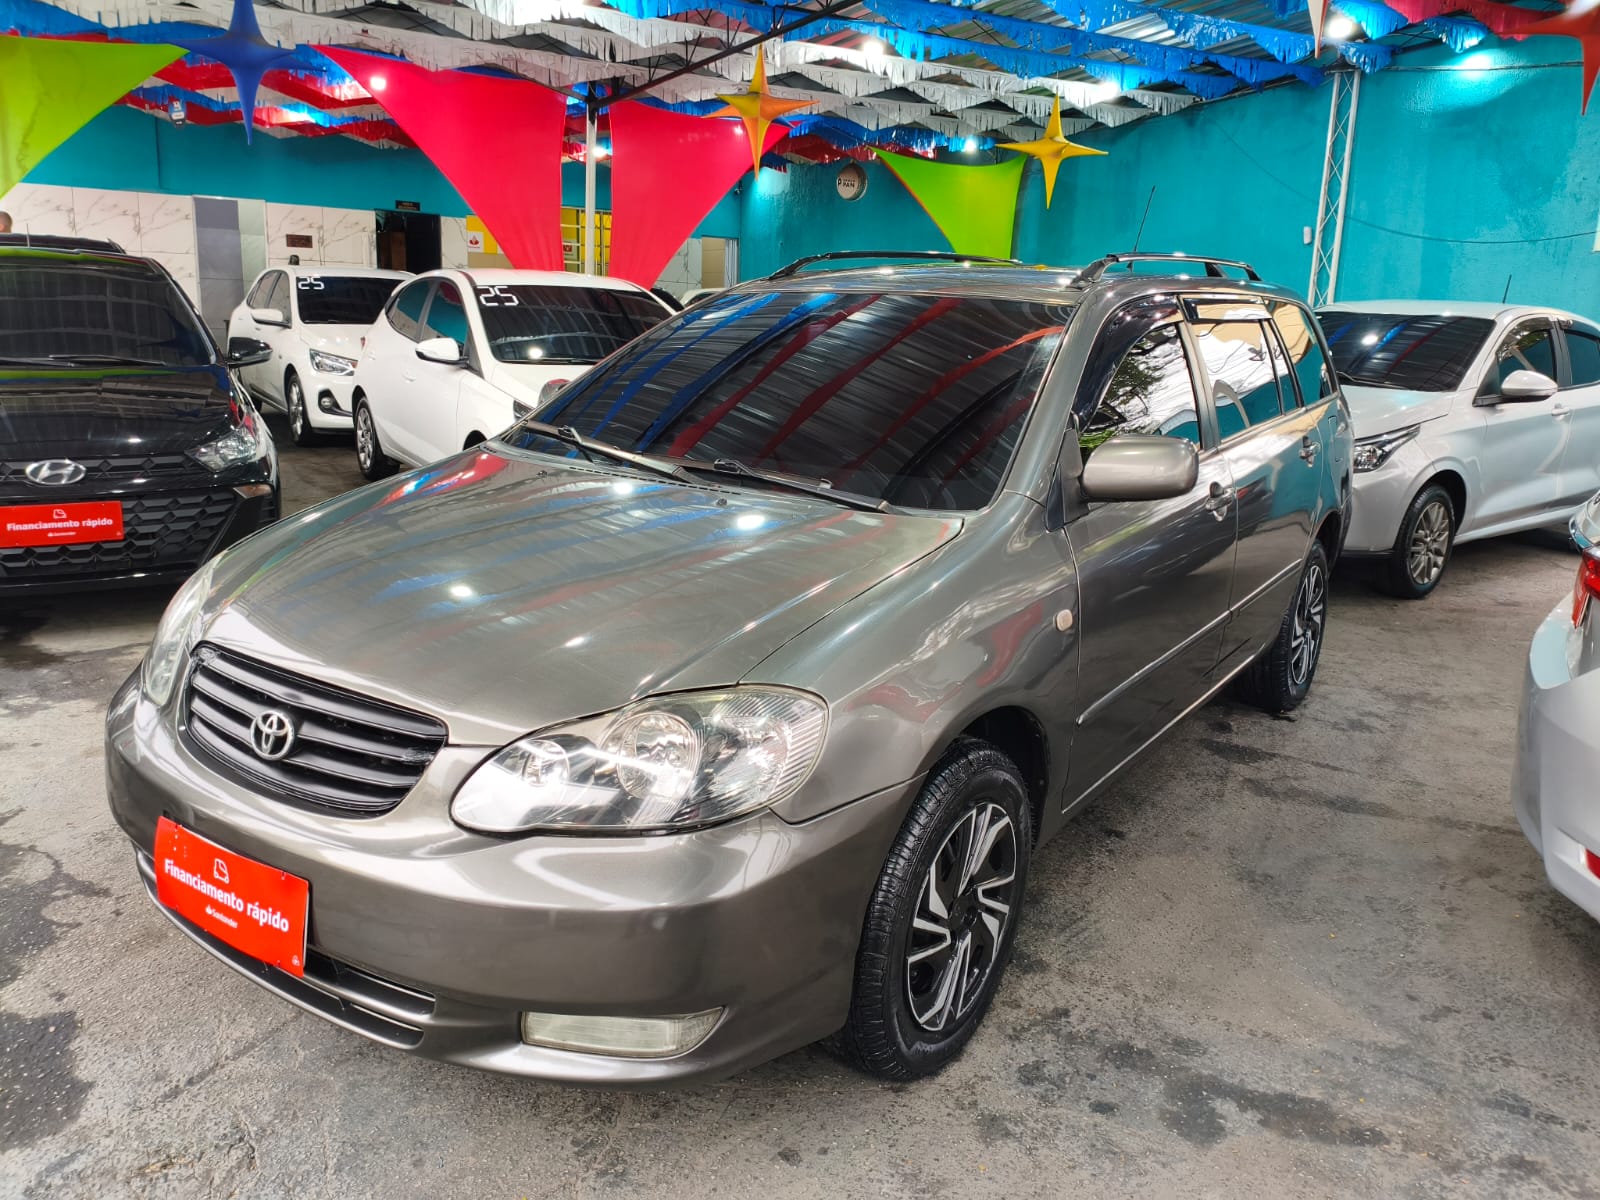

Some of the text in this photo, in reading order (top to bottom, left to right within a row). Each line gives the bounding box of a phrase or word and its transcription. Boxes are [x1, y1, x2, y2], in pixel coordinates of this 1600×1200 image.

[298, 274, 325, 290] 25
[477, 285, 519, 306] 25
[6, 518, 113, 531] Financiamento rápido
[164, 858, 289, 932] Financiamento rápido
[211, 908, 239, 929] Santander
